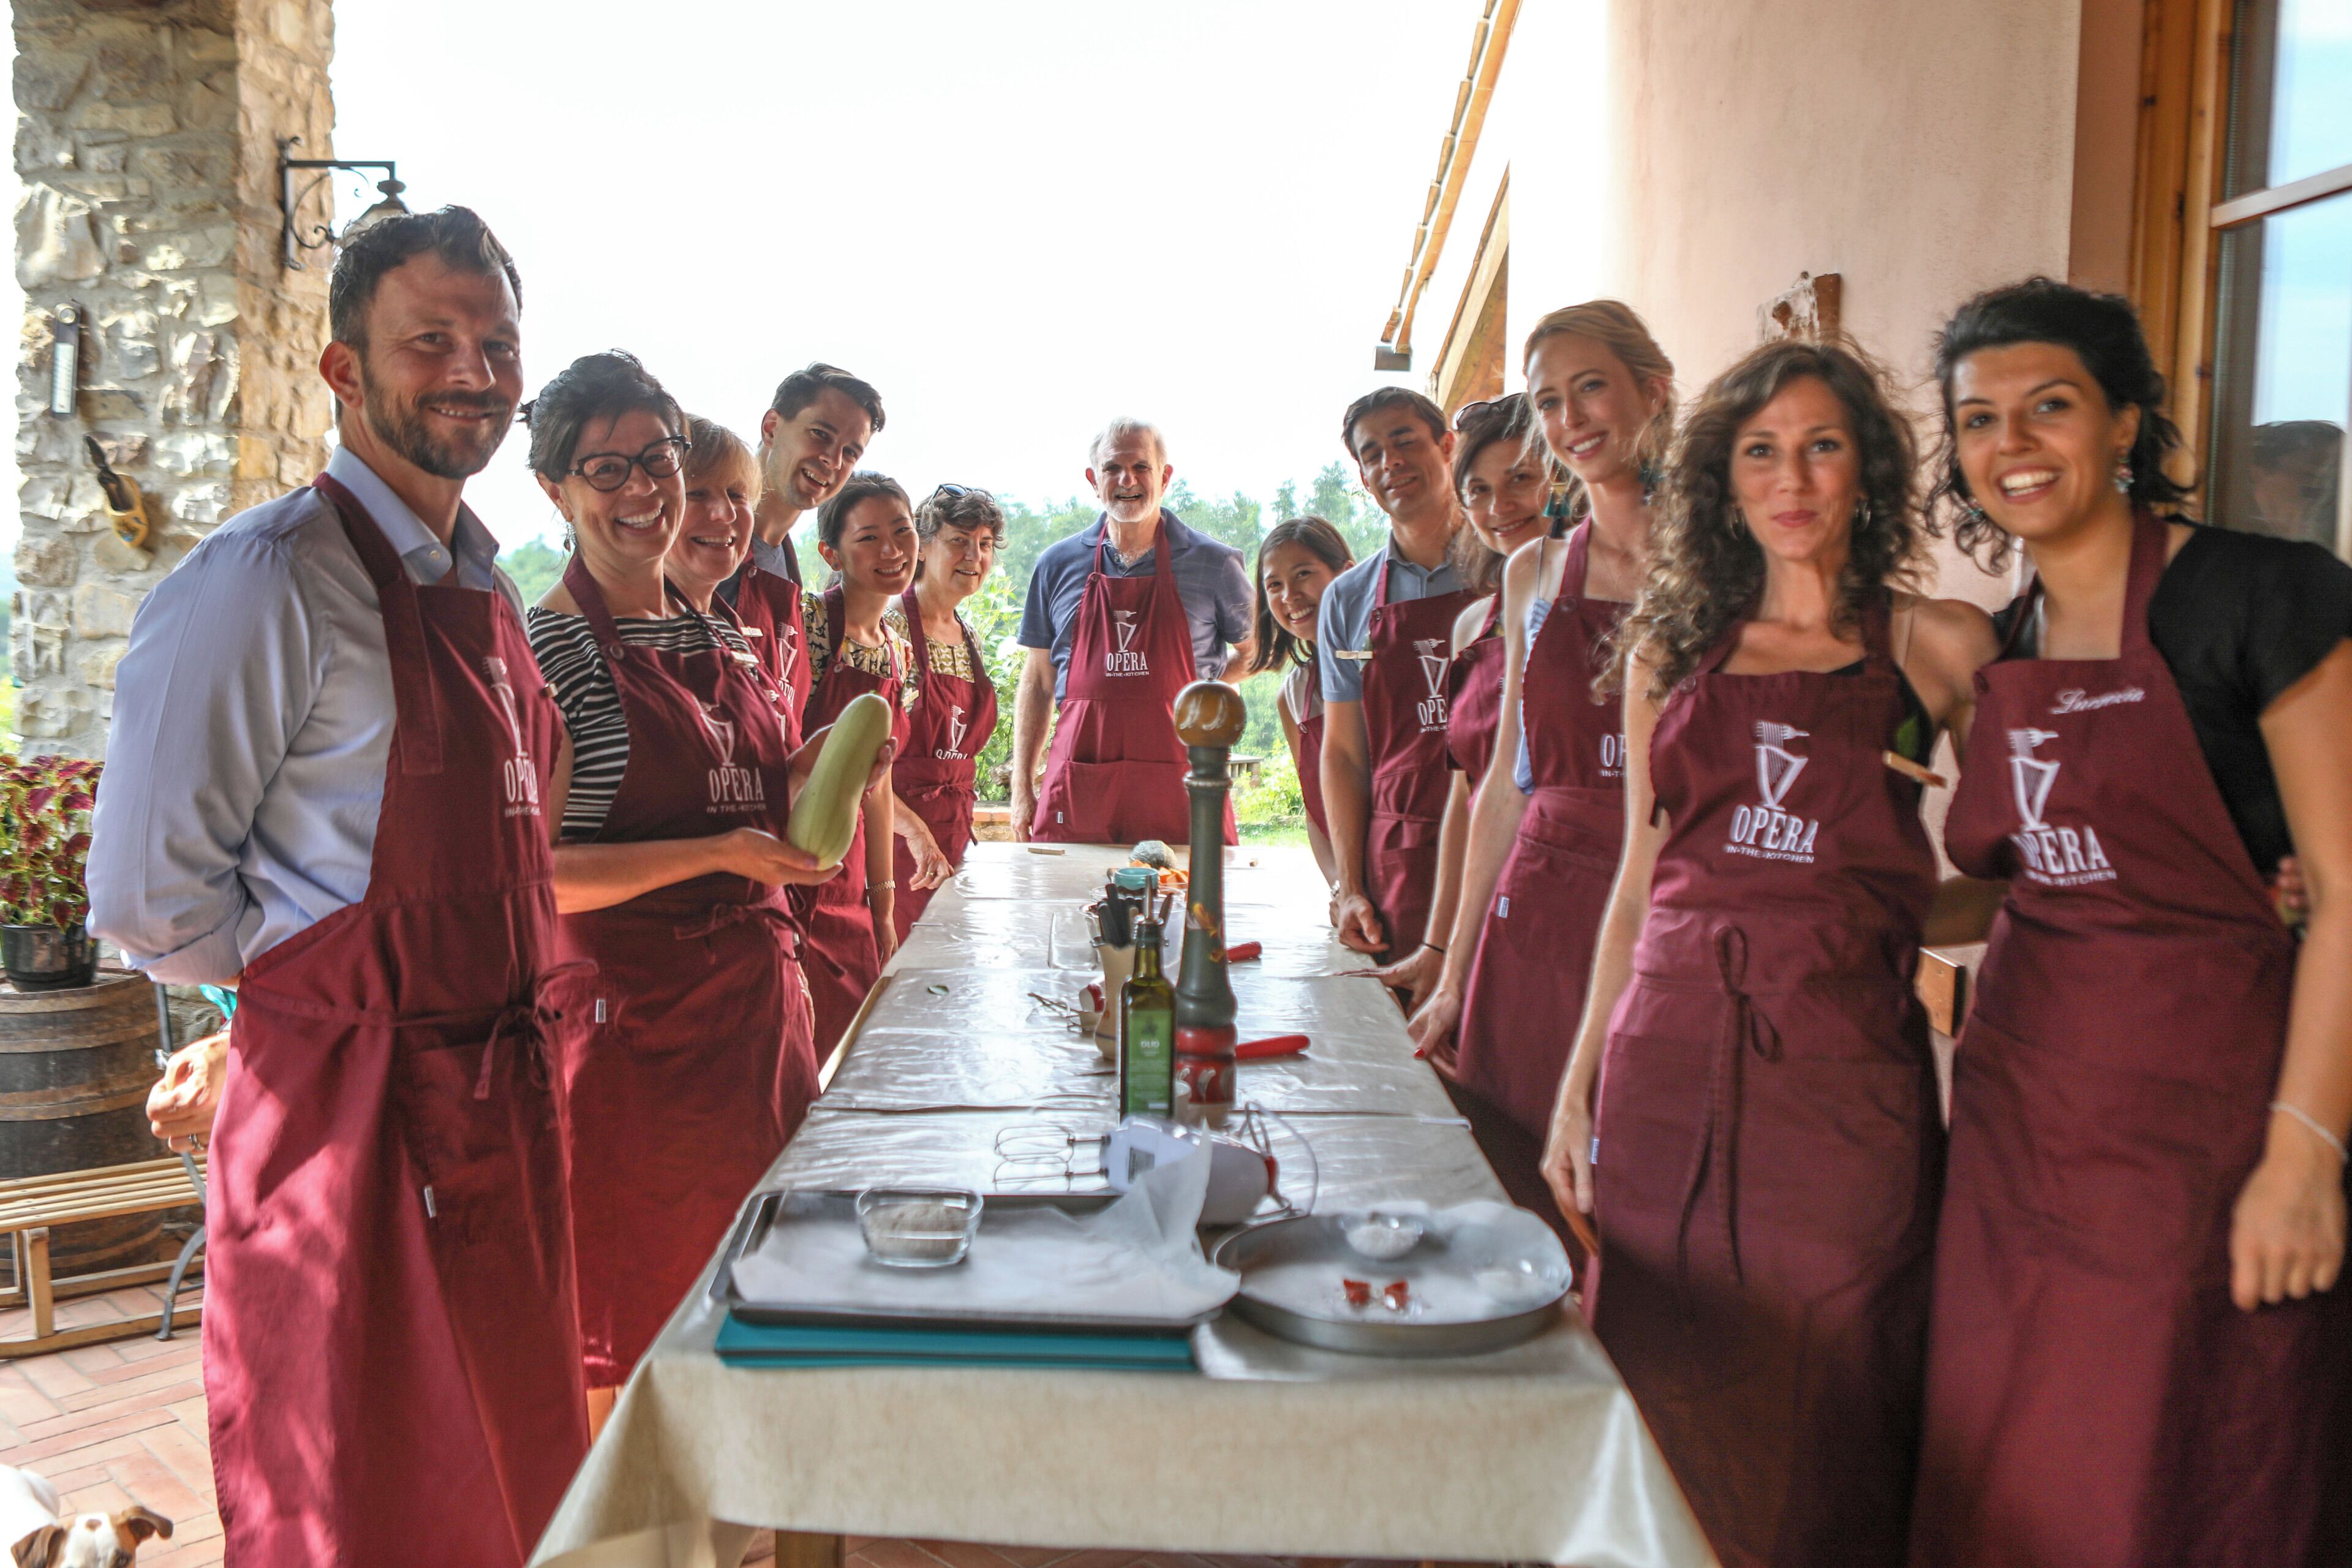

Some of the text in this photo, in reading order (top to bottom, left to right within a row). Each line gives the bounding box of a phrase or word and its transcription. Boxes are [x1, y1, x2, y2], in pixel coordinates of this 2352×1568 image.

[1106, 651, 1148, 671] OPERA
[1417, 698, 1448, 726] OPE
[504, 757, 539, 804] OPE
[708, 767, 764, 803] OPERA
[1729, 803, 1819, 853] OPERA
[2024, 869, 2117, 887] -KITCHEN
